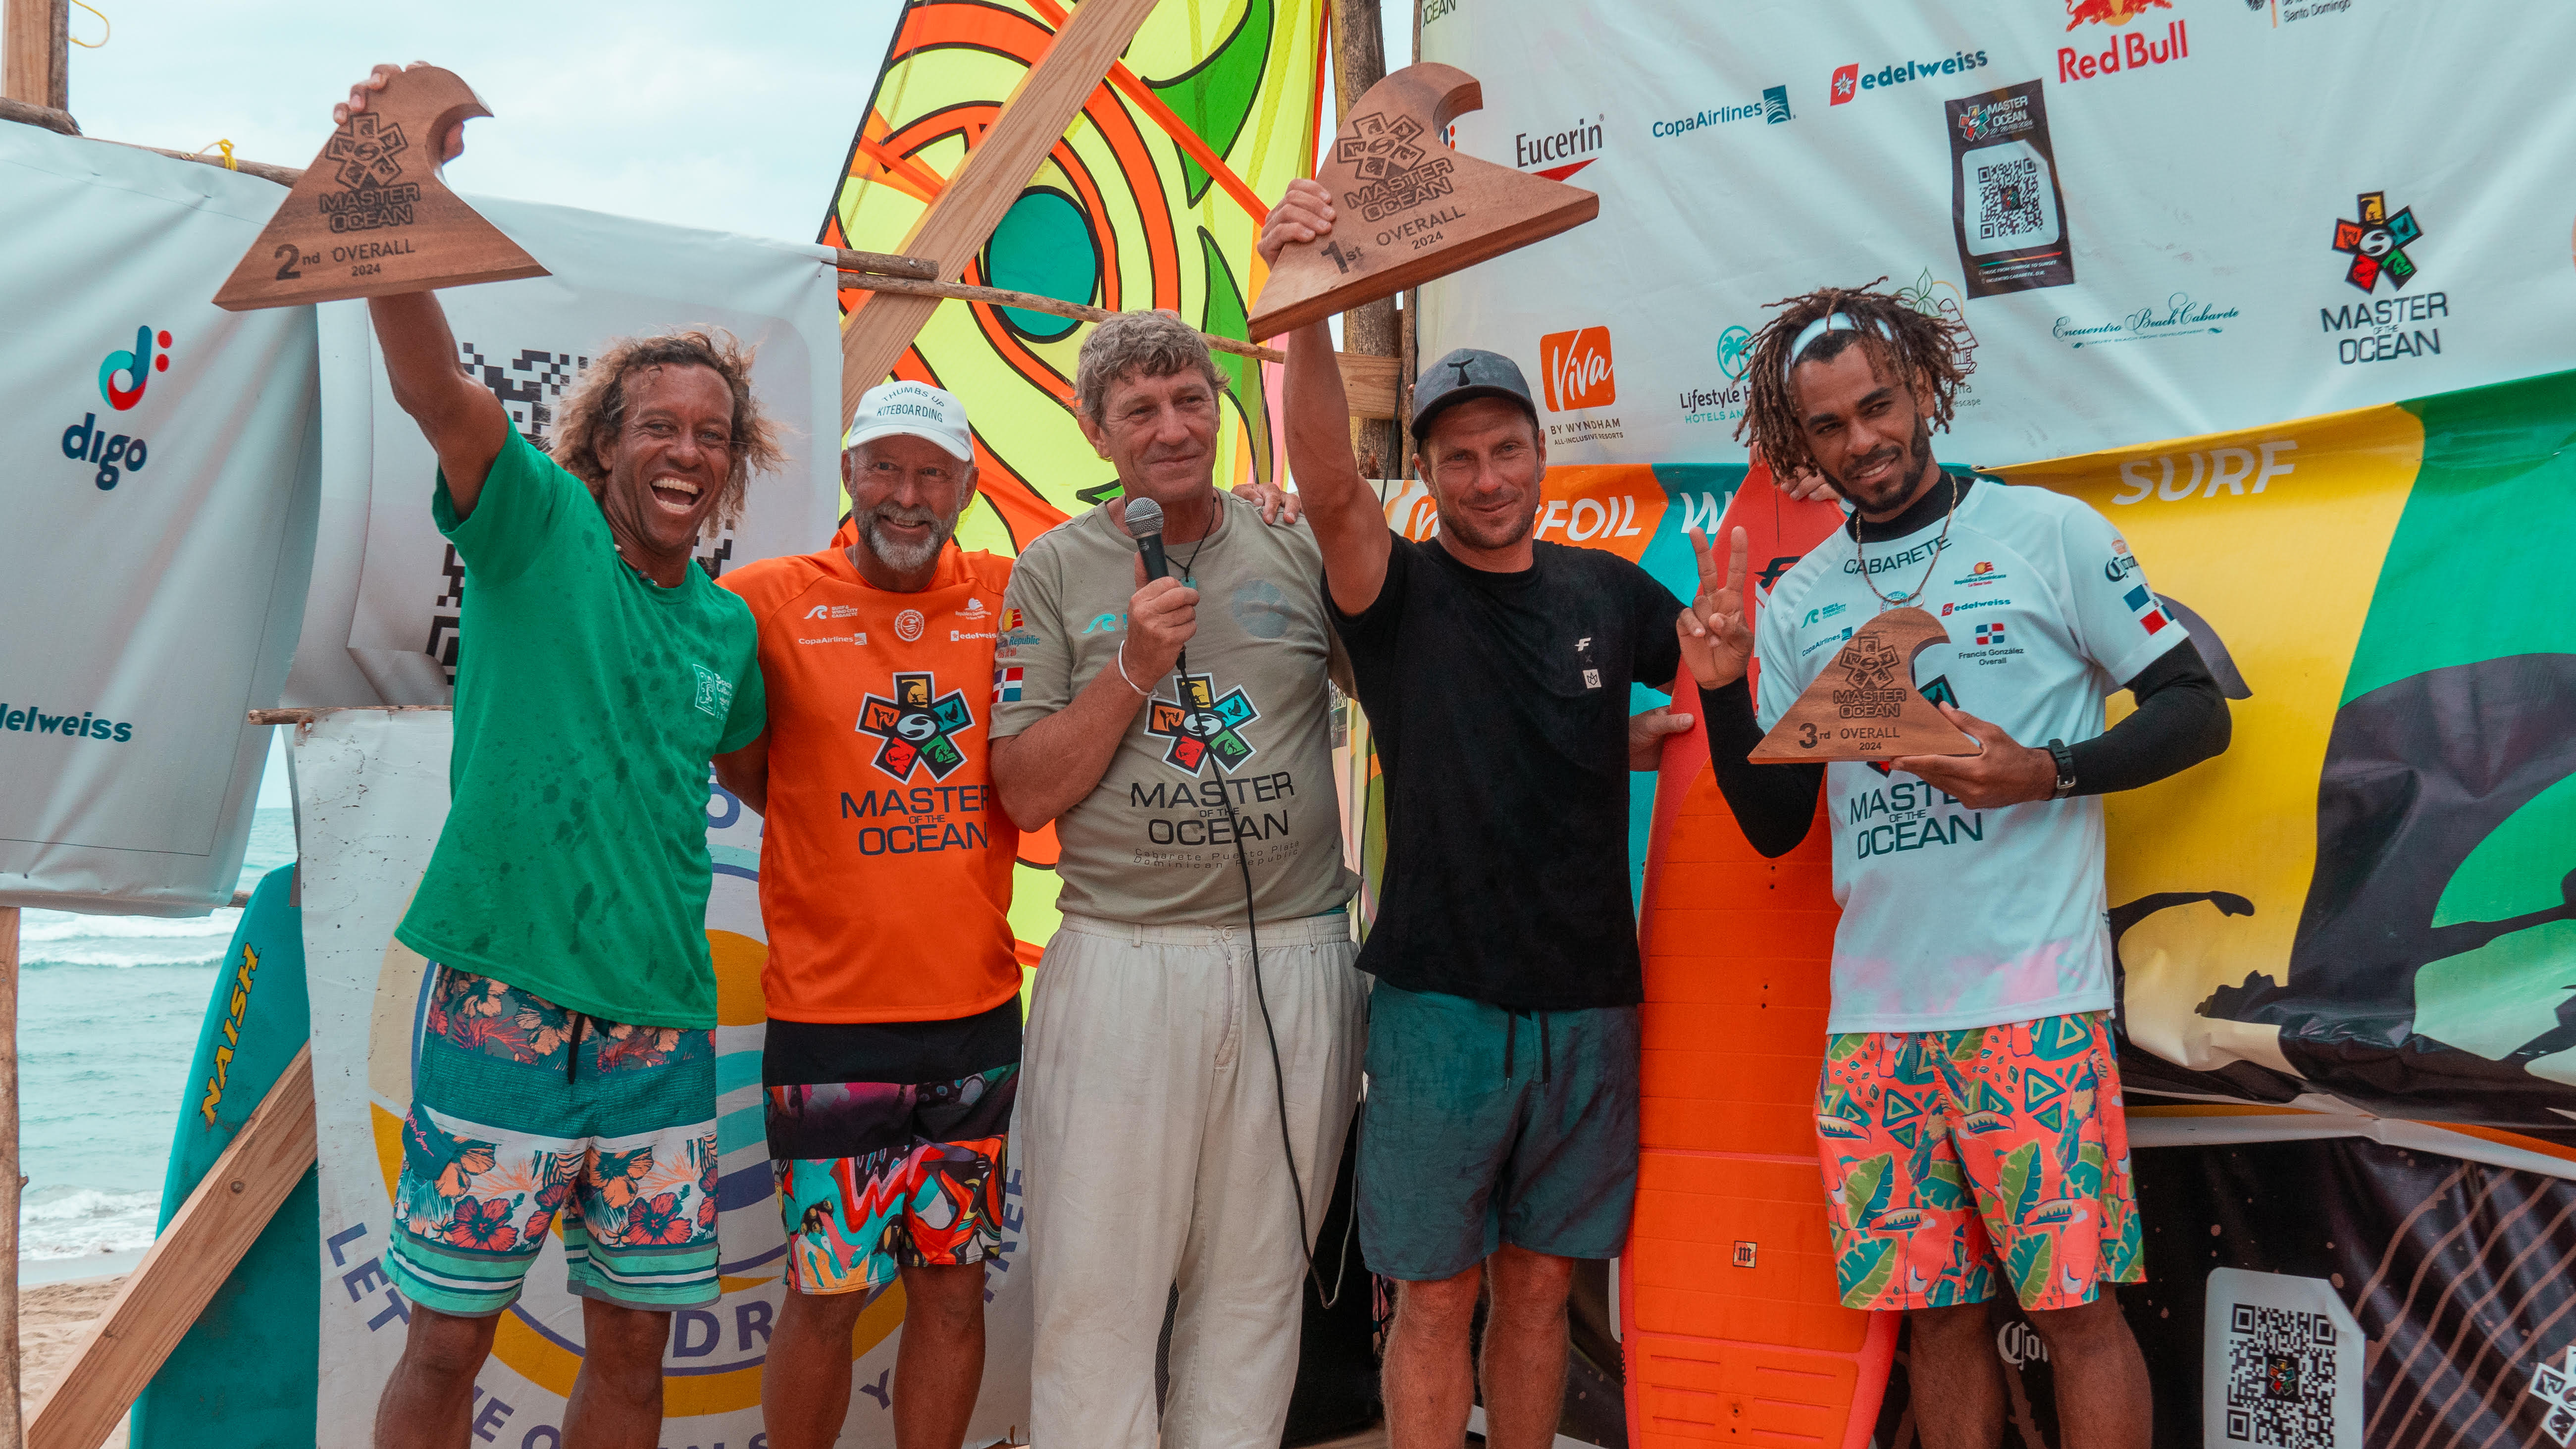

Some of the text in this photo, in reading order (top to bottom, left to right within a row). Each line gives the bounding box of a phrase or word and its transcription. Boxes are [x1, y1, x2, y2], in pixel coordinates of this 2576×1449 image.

[2283, 8, 2309, 23] Santo
[2058, 19, 2189, 84] Red Bull
[1860, 50, 1988, 90] edelweiss
[1987, 95, 2028, 115] MASTER
[1652, 100, 1763, 138] CopaAirlines
[1993, 109, 2027, 127] OCEAN
[1516, 118, 1603, 168] Eucerin
[1344, 157, 1454, 209] MASTER
[319, 182, 420, 213] MASTER
[1362, 176, 1454, 222] OCEAN
[329, 204, 414, 234] OCEAN
[1376, 206, 1466, 246] OVERALL
[331, 239, 415, 262] OVERALL
[1411, 231, 1443, 250] 2024
[352, 263, 381, 277] 2024
[2053, 291, 2239, 342] Encuentro Beach Cabarete
[2320, 292, 2448, 333] MASTER
[2372, 324, 2399, 335] OF THE
[2339, 328, 2440, 365] OCEAN
[1552, 329, 1613, 412] Viva
[882, 387, 944, 408] THUMBS UP
[1680, 388, 1740, 414] Lifestyle
[876, 404, 943, 423] KITEBOARDING
[1685, 409, 1743, 424] HOTELS AN
[1550, 418, 1621, 435] BY WYNDHAM
[1554, 433, 1598, 445] ALL-INCLUSIVE
[61, 412, 147, 491] digo
[2112, 440, 2298, 506] SURF
[1534, 495, 1642, 541] FOIL
[1844, 535, 1952, 574] CABARETE
[1954, 598, 2011, 611] edelweiss
[798, 635, 854, 646] CopaAirlines
[1009, 635, 1040, 646] Republic
[1802, 633, 1841, 657] CopaAirlines
[1958, 647, 2024, 659] Francis González
[1979, 657, 2007, 666] Overall
[1833, 688, 1906, 704] MASTER
[1839, 703, 1901, 719] OCEAN
[1840, 726, 1901, 739] OVERALL
[1859, 742, 1882, 751] 2024
[841, 784, 989, 819] MASTER
[1131, 771, 1294, 809] MASTER
[1199, 807, 1240, 818] OF THE
[1851, 780, 1961, 825] MAST
[909, 814, 945, 825] OF THE
[1148, 809, 1289, 845] OCEAN
[1889, 809, 1926, 823] OF THE
[858, 821, 988, 856] OCEAN
[1857, 812, 1983, 860] OCEAN
[1133, 849, 1298, 869] Dominican Republic
[1135, 840, 1299, 861] Cabarete Puerto Plata
[199, 942, 260, 1133] NAISH
[326, 1222, 411, 1332] LET
